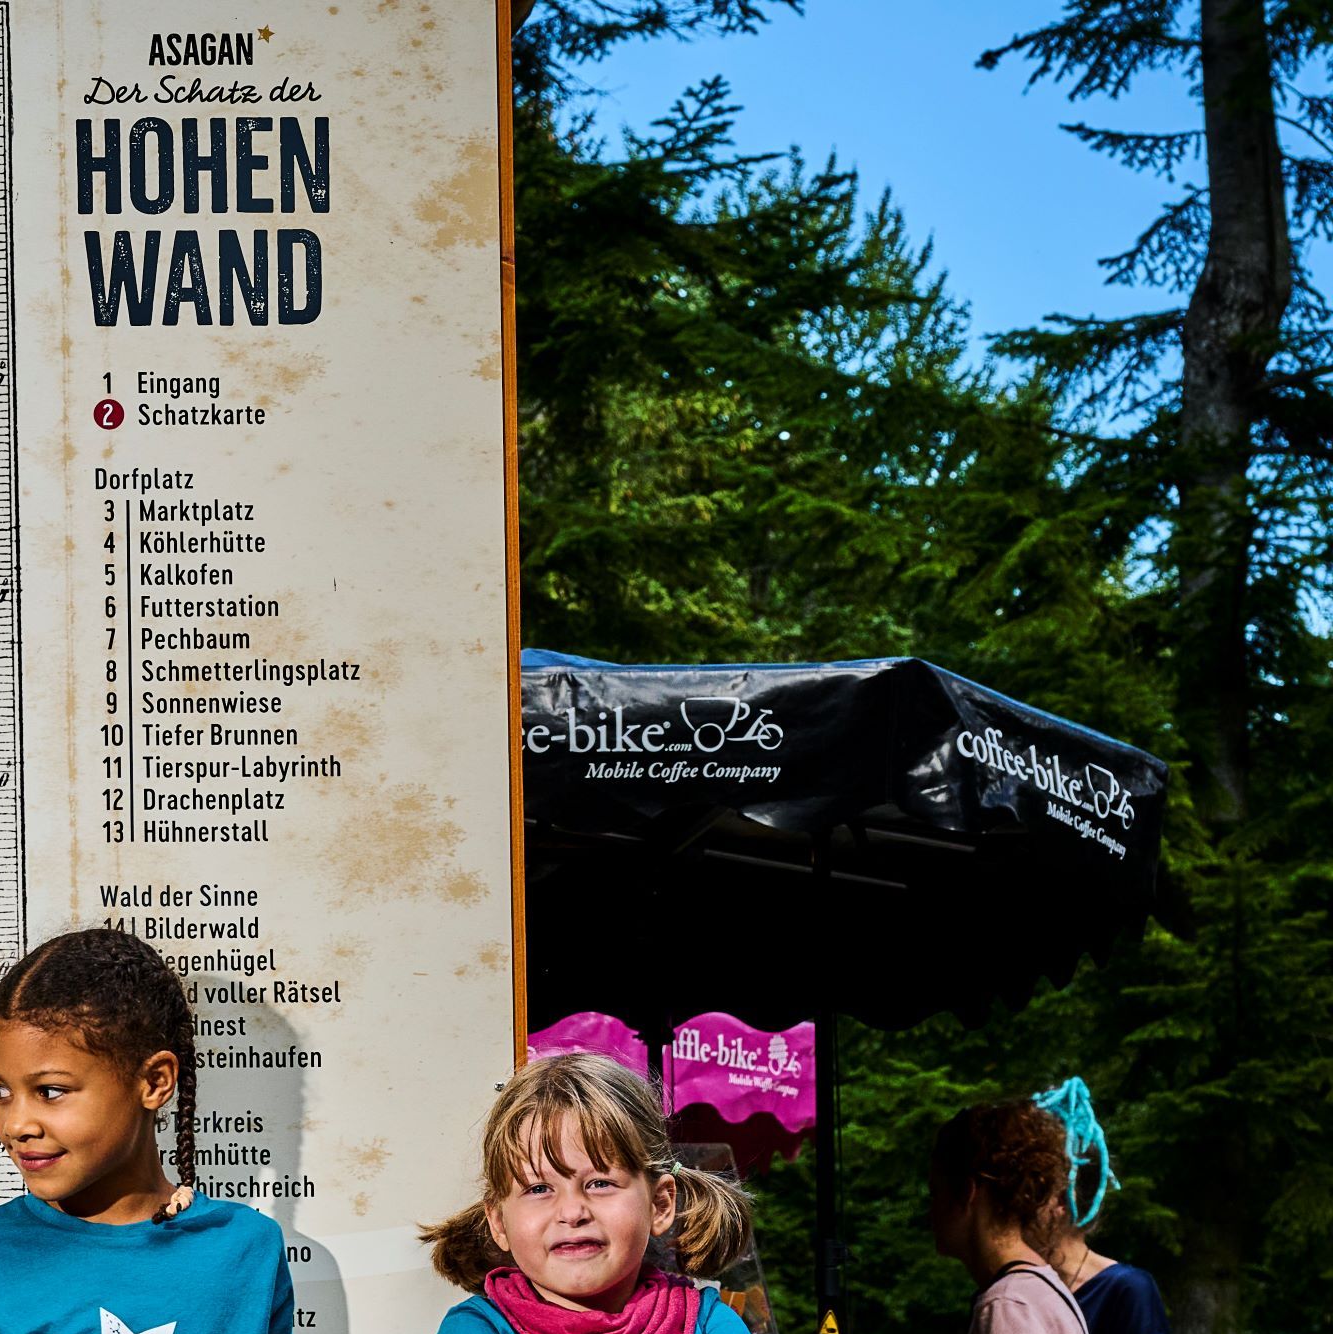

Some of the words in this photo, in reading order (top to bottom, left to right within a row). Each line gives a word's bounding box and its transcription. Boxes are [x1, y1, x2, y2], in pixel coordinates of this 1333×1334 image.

[148, 33, 254, 66] ASAGAN
[84, 76, 148, 105] Der
[153, 75, 262, 104] Schatz
[269, 76, 321, 102] der
[76, 116, 330, 214] HOHEN
[84, 229, 322, 326] WAND
[102, 372, 113, 393] 1
[137, 371, 221, 399] Eingang
[102, 404, 114, 426] 2
[138, 403, 266, 426] Schatzkarte
[95, 467, 194, 495] Dorfplatz
[104, 500, 115, 521] 3
[139, 499, 254, 526] Marktplatz
[103, 532, 115, 553] 4
[140, 530, 266, 553] Köhlerhütte
[105, 564, 115, 586] 5
[140, 563, 233, 586] Kalkofen
[105, 596, 116, 618] 6
[141, 594, 279, 618] Futterstation
[106, 628, 116, 650] 7
[141, 627, 250, 650] Pechbaum
[106, 660, 117, 682] 8
[142, 658, 360, 686] Schmetterlingsplatz
[106, 692, 117, 714] 9
[142, 691, 282, 714] Sonnenwiese
[101, 724, 124, 746] 10
[142, 723, 204, 746] Tiefer
[210, 723, 298, 746] Brunnen
[102, 757, 123, 778] 11
[143, 754, 342, 784] Tierspur-Labyrinth
[585, 762, 644, 779] Mobile
[648, 761, 697, 783] Coffee
[702, 762, 781, 782] Company
[102, 789, 124, 811] 12
[143, 787, 285, 815] Drachenplatz
[102, 821, 124, 843] 13
[144, 819, 268, 843] Hühnerstall
[1046, 801, 1074, 826] Mobile
[1074, 815, 1096, 839] Coffee
[1096, 828, 1126, 860] Company
[100, 885, 151, 907] Wald
[159, 884, 193, 907] der
[199, 883, 258, 907] Sinne
[146, 916, 259, 939] Bilderwald
[205, 981, 266, 1004] voller
[273, 980, 341, 1004] Rätsel
